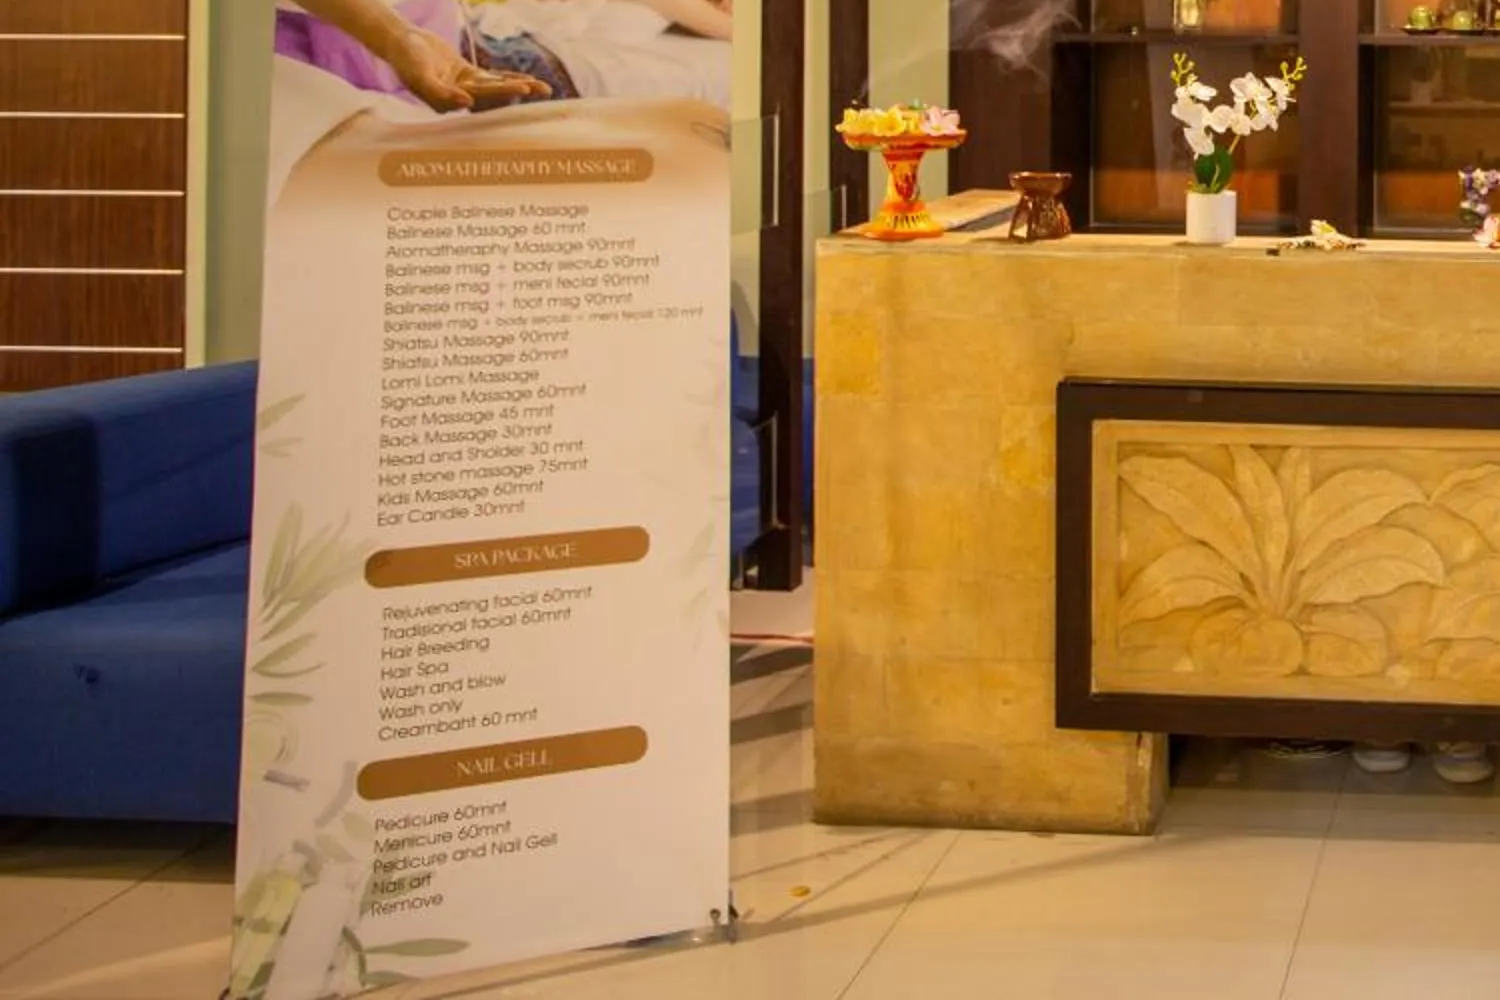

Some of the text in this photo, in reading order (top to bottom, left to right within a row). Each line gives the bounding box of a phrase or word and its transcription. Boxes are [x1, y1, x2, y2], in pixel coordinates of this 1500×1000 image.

[557, 158, 636, 175] MASSAGE
[451, 204, 515, 219] Balinese
[519, 202, 589, 219] Massage
[386, 221, 586, 240] Balinese Massage 60 mnt
[514, 240, 583, 256] Massage
[587, 238, 636, 252] 90mnt
[386, 263, 451, 278] Balinese
[456, 262, 490, 277] msg
[513, 257, 554, 272] body
[612, 254, 659, 269] 90mnt
[384, 283, 451, 298] Balinese
[455, 281, 490, 295] msg
[602, 274, 650, 288] 90mnt
[384, 301, 450, 316] Balinese
[454, 299, 489, 315] msg
[513, 296, 544, 309] foot
[548, 294, 581, 309] msg
[584, 293, 633, 306] 90mnt
[383, 318, 443, 334] Balinese
[447, 317, 478, 331] msg
[382, 329, 569, 351] Shiatsu Massage 90mnt
[382, 348, 569, 371] Shiatsu Massage 60mnt
[382, 368, 539, 391] Lomi Lomi Massage
[381, 384, 587, 411] Signature Massage 60mnt
[380, 414, 418, 429] Foot
[421, 408, 494, 425] Massage
[522, 404, 554, 418] mnt
[379, 423, 553, 448] Back Massage 30mnt
[379, 439, 584, 468] Head and Sholder 30 mnt
[378, 473, 408, 488] Hot
[410, 469, 456, 484] stone
[459, 464, 535, 479] massage
[377, 479, 544, 506] Kids Massage 60mnt
[376, 501, 525, 527] Ear Candle 30mnt
[382, 586, 592, 622] Rejuvenating facial 60mnt
[381, 607, 572, 641] Tradisional facial 60mnt
[381, 636, 491, 662] Hair Breeding
[381, 662, 450, 681] Hair Spa
[379, 674, 507, 701] Wash and blow
[379, 699, 464, 721] Wash only
[481, 712, 501, 728] 60
[504, 708, 538, 724] mnt
[455, 749, 551, 777] NAIL GELL
[375, 801, 508, 833] Pedicure 60mnt
[373, 821, 512, 853] Menicure 60mnt
[373, 833, 558, 874] Pedicure and Nail Gell
[371, 873, 433, 894] Nail art
[371, 892, 443, 916] Remove
